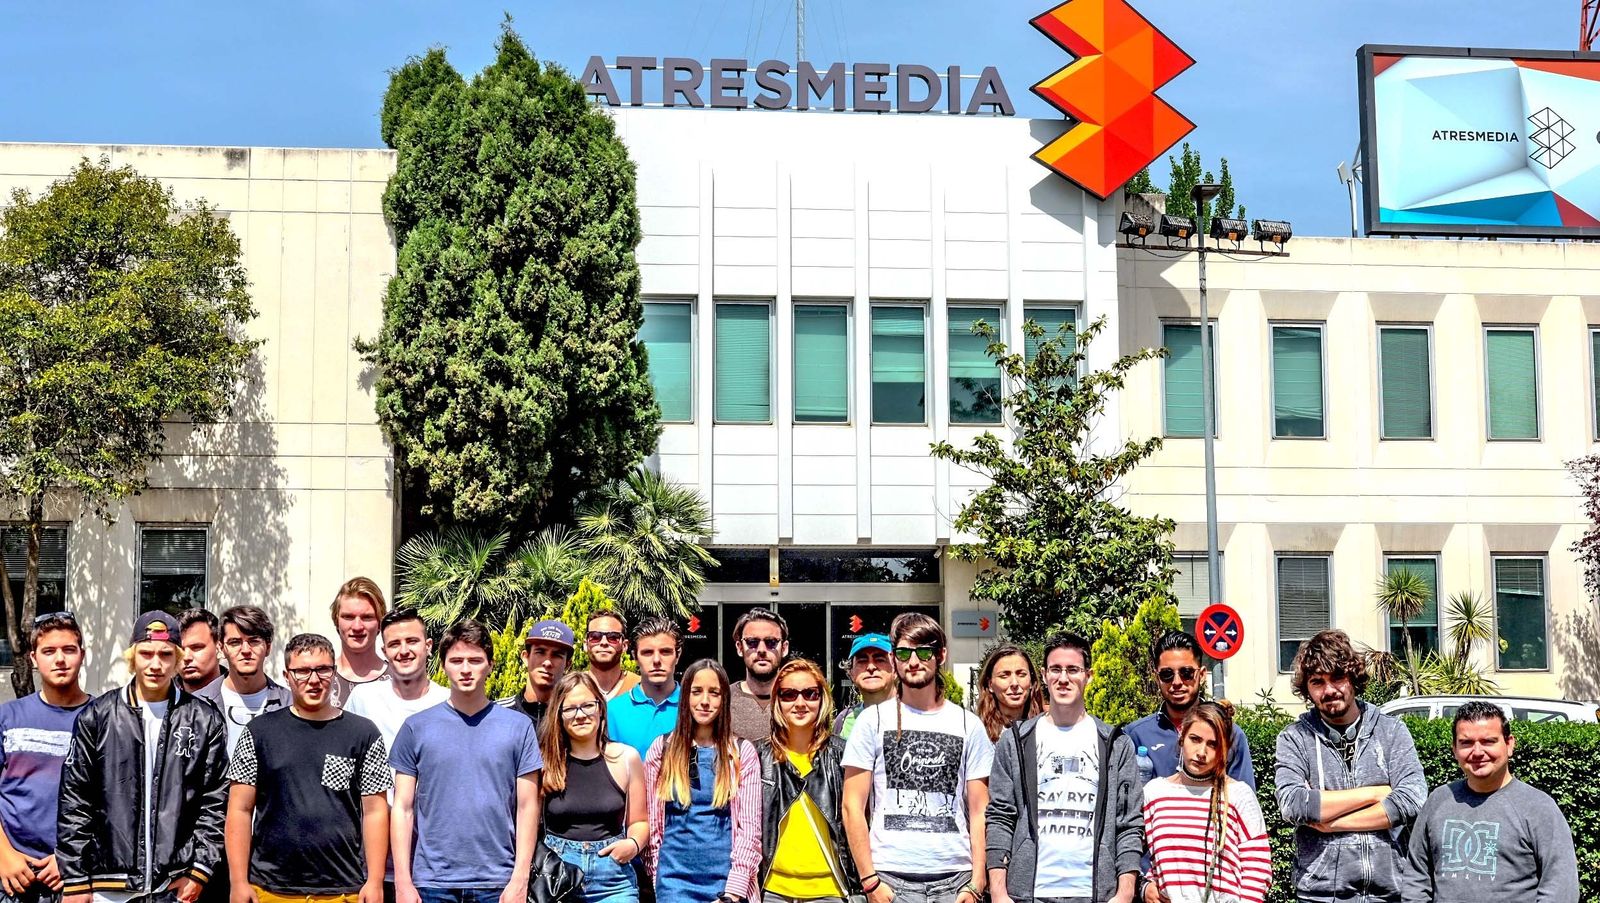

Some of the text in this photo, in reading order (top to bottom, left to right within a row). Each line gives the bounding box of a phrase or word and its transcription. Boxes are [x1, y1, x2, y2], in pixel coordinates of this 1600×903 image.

[580, 55, 1016, 116] ATRESMEDIA
[1432, 129, 1520, 143] ATRESMEDIA
[901, 751, 947, 772] Originals
[1037, 791, 1063, 802] SAY
[1038, 824, 1093, 838] AMERA
